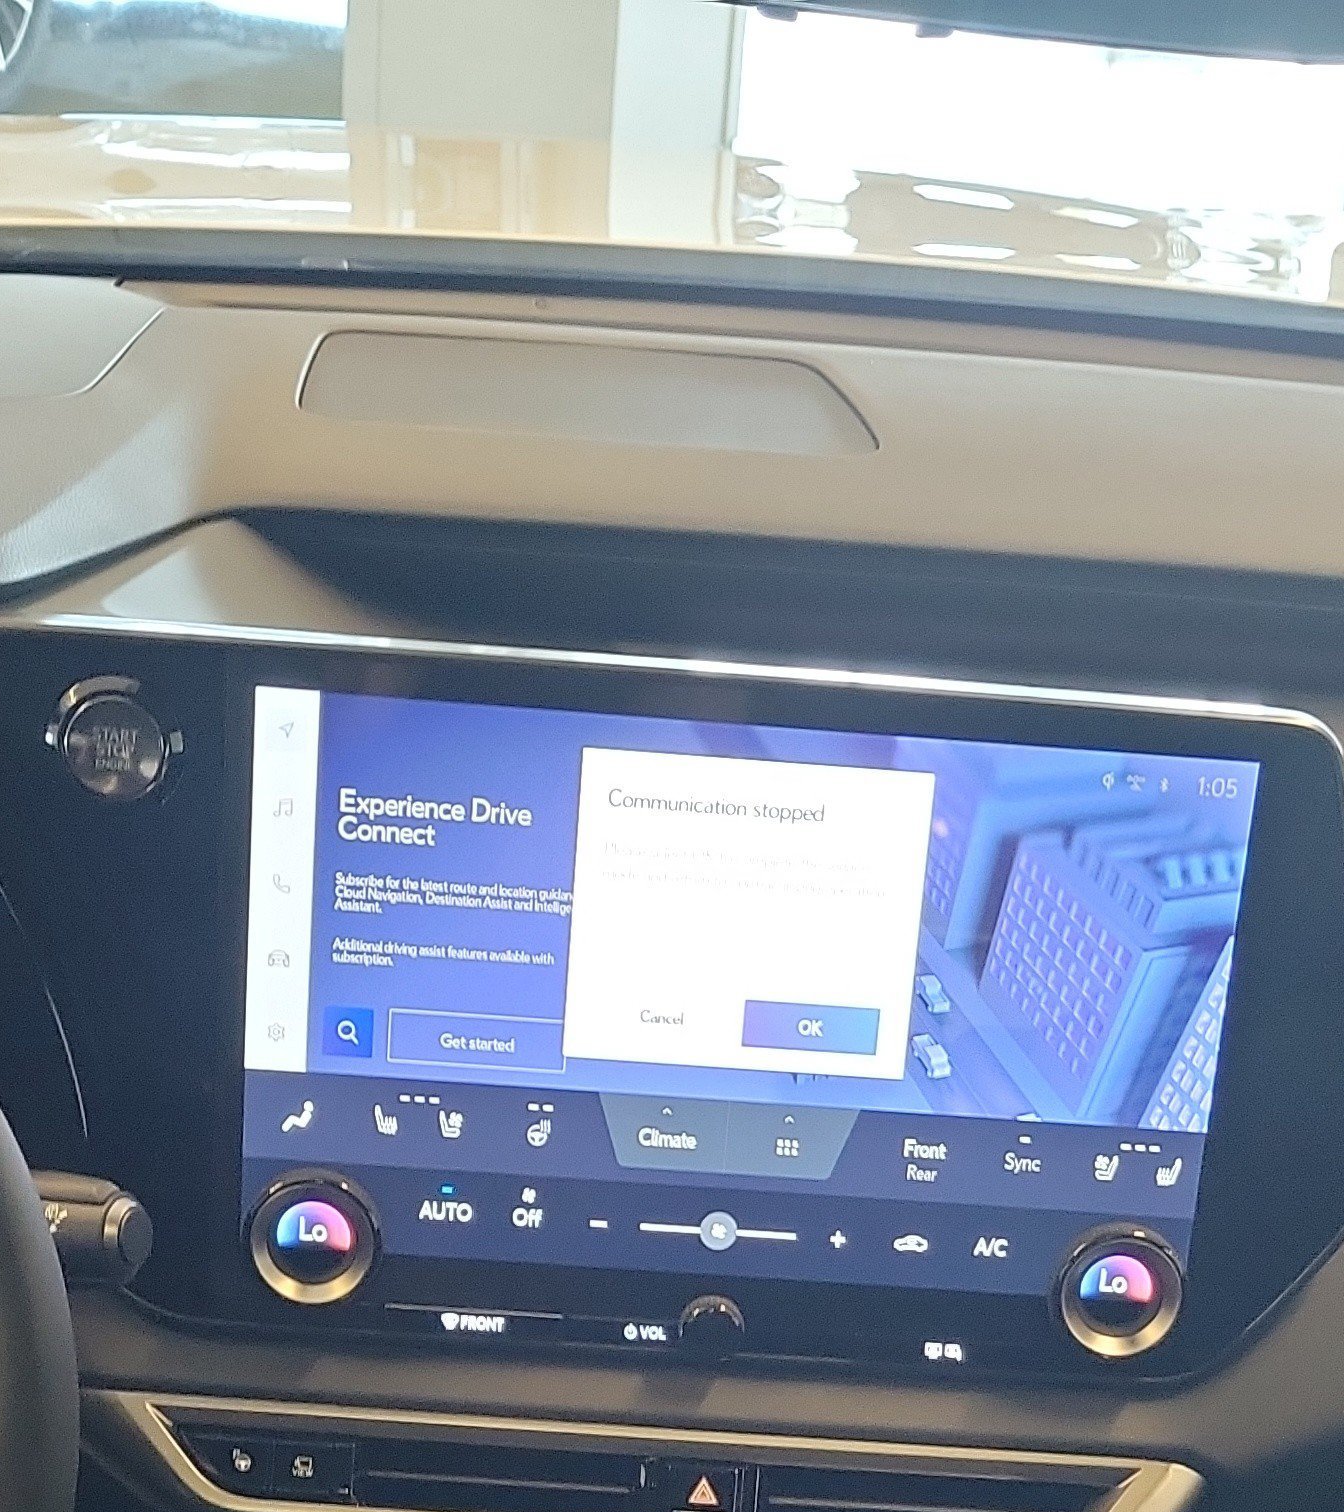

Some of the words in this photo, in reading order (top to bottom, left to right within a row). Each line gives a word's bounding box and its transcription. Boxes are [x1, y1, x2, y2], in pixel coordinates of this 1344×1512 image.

[1196, 776, 1239, 799] 1:05
[338, 787, 465, 822] Experience
[470, 797, 533, 828] Drive
[608, 788, 747, 817] Communication
[753, 804, 826, 824] stopped
[337, 815, 436, 847] Connect
[335, 871, 384, 889] Subscribe
[385, 874, 400, 890] for
[402, 876, 419, 891] the
[420, 878, 449, 893] latest
[449, 882, 477, 896] route
[478, 883, 498, 897] and
[499, 883, 537, 899] location
[538, 887, 573, 902] guidan
[334, 885, 366, 900] Cloud
[367, 887, 424, 905] Navigation,
[425, 891, 482, 908] Destination
[483, 895, 513, 910] Assist
[513, 898, 534, 912] and
[334, 897, 384, 914] Assistant.
[331, 949, 394, 968] subscription.
[332, 936, 383, 954] Additional
[383, 940, 418, 959] driving
[418, 945, 446, 959] assist
[447, 945, 488, 961] features
[489, 949, 531, 964] available
[531, 952, 555, 966] with
[639, 1009, 685, 1026] Cancel
[797, 1018, 824, 1038] OK
[439, 1031, 465, 1051] Get
[468, 1034, 516, 1053] started
[637, 1127, 698, 1151] Climate
[903, 1138, 949, 1161] Front
[905, 1164, 938, 1184] Rear
[1003, 1152, 1042, 1175] Sync
[418, 1200, 474, 1224] AUTO
[511, 1206, 543, 1228] Off
[297, 1215, 329, 1244] Lo
[972, 1237, 1009, 1258] A/C
[1098, 1267, 1129, 1294] Lo
[458, 1314, 505, 1334] FRONT
[639, 1324, 667, 1341] VOL
